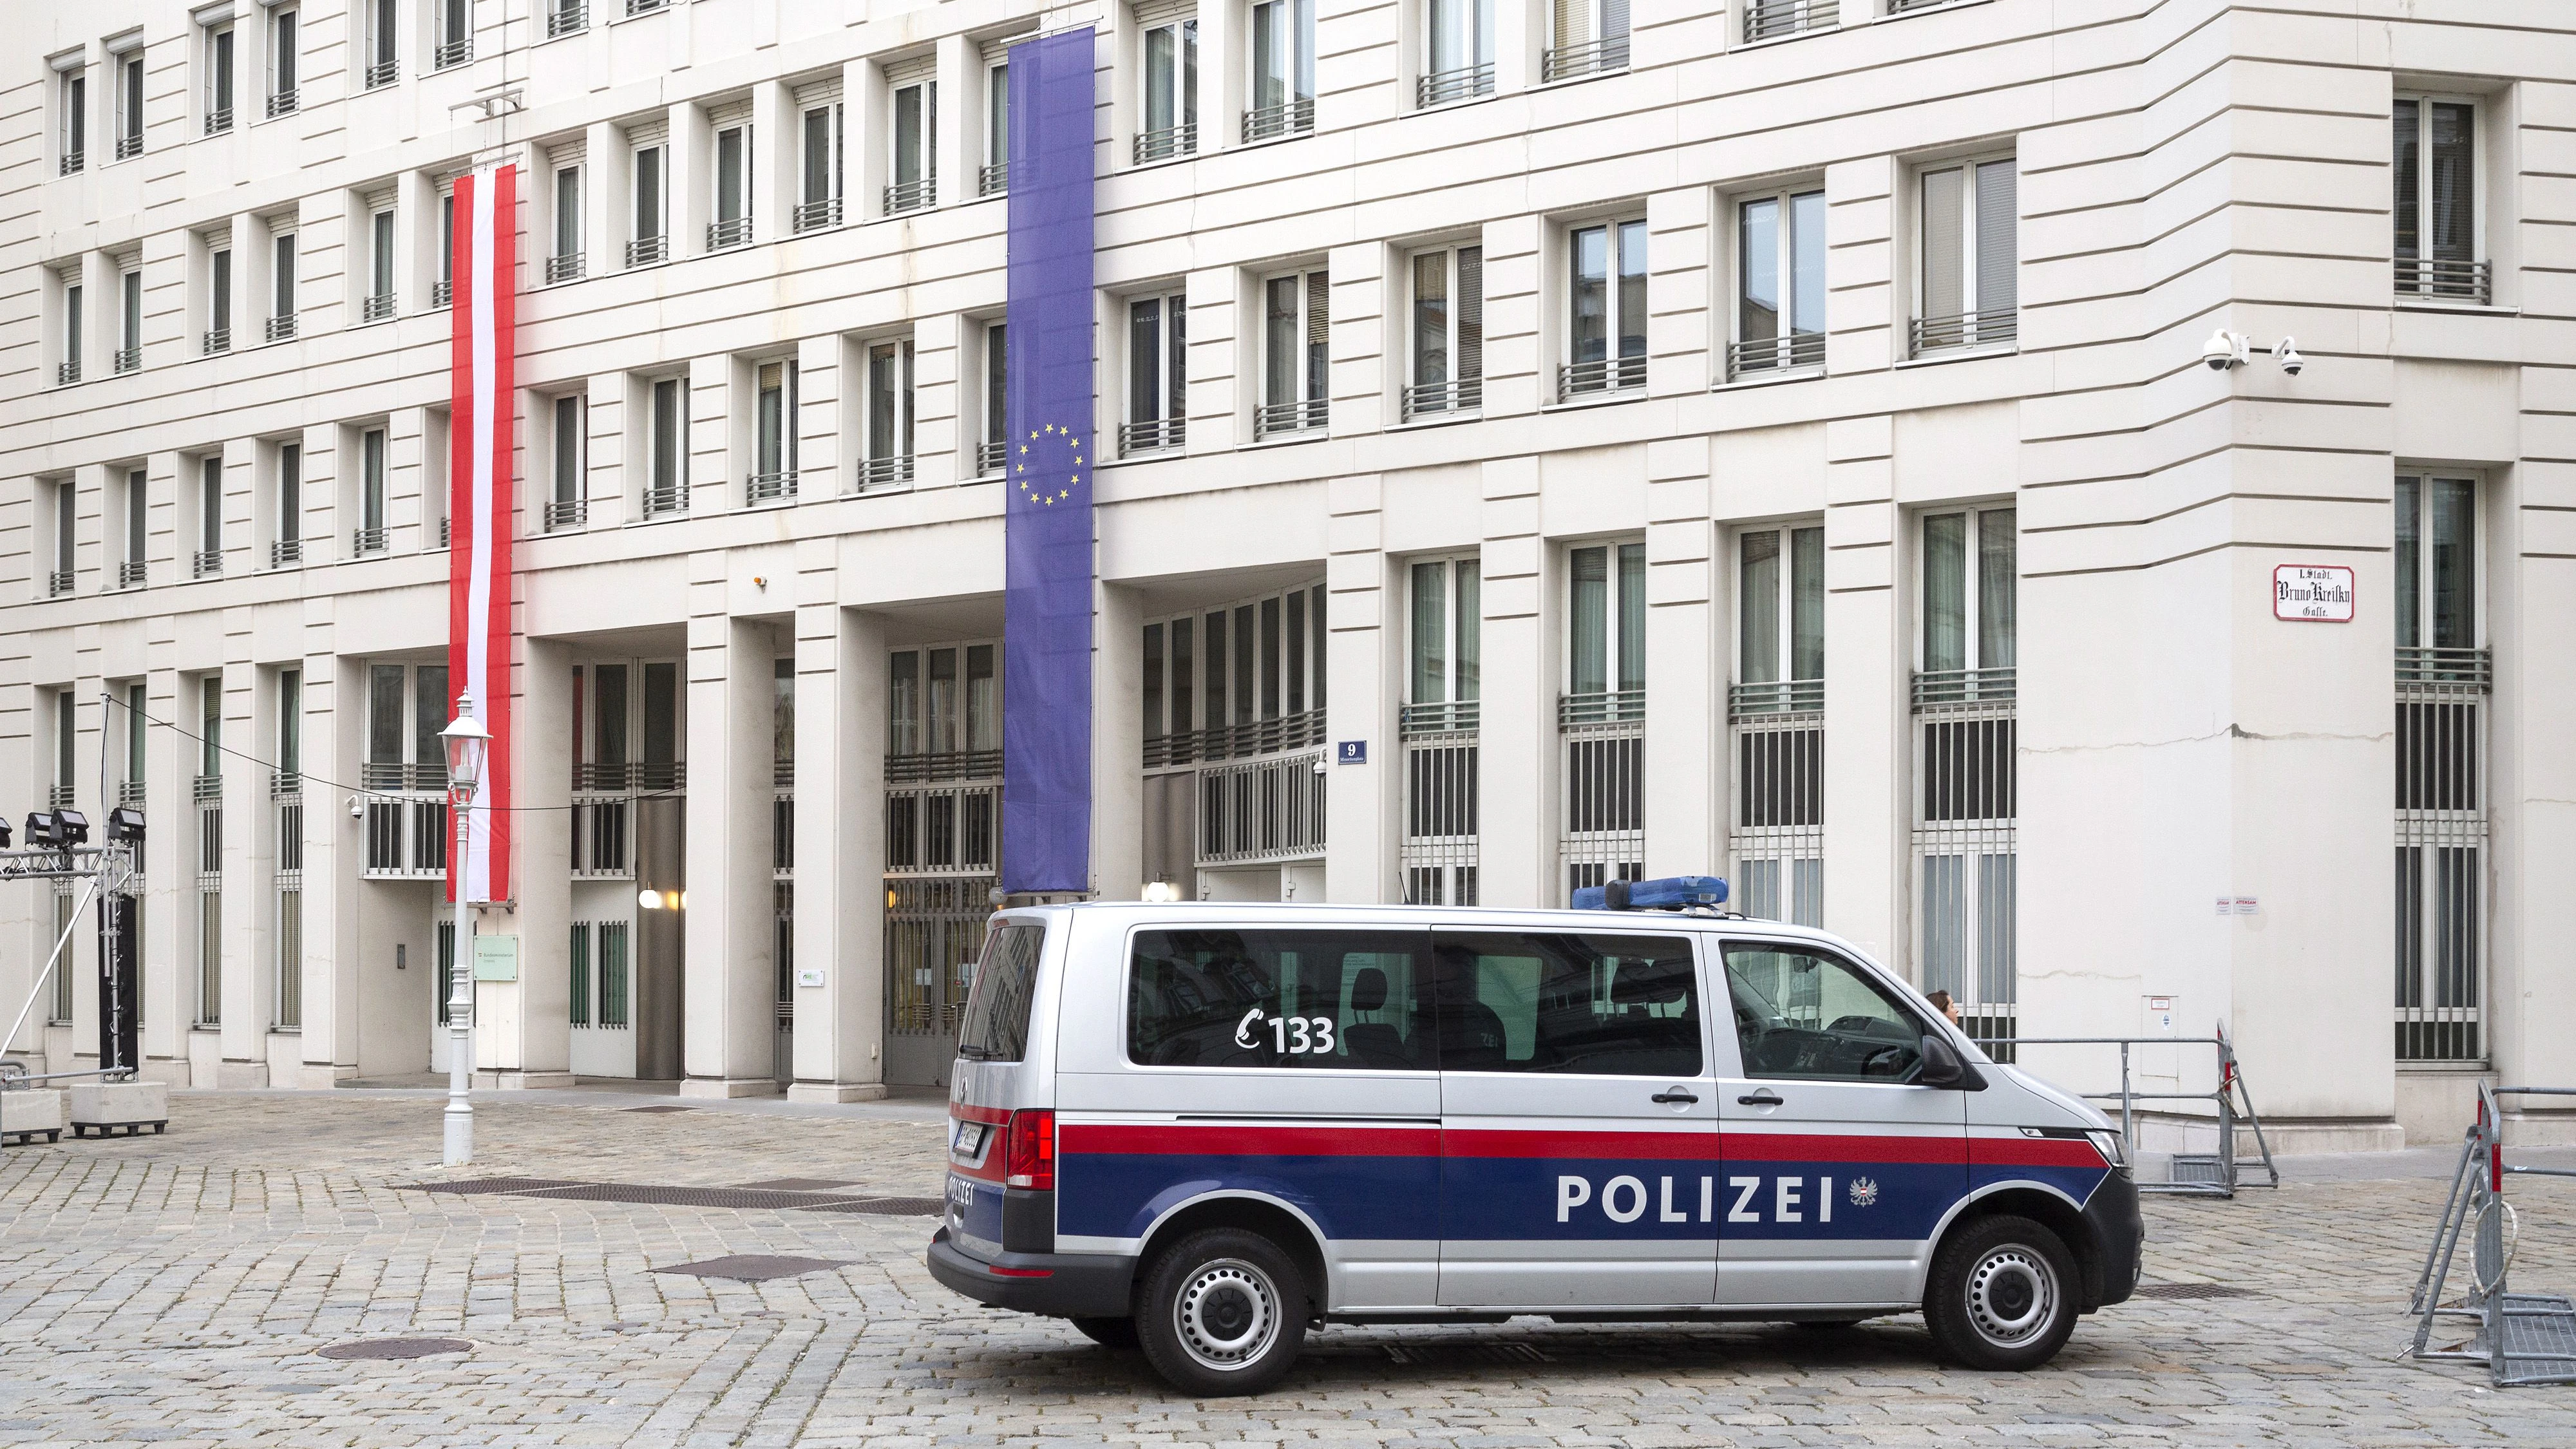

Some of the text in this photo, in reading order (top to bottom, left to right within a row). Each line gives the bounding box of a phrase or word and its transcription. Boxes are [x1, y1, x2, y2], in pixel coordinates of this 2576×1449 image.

[2277, 580, 2311, 603] Bruno
[1348, 744, 1356, 756] 9
[1268, 1017, 1334, 1054] 133
[948, 1177, 974, 1206] POLIZEI
[1557, 1175, 1832, 1223] POLIZEI
